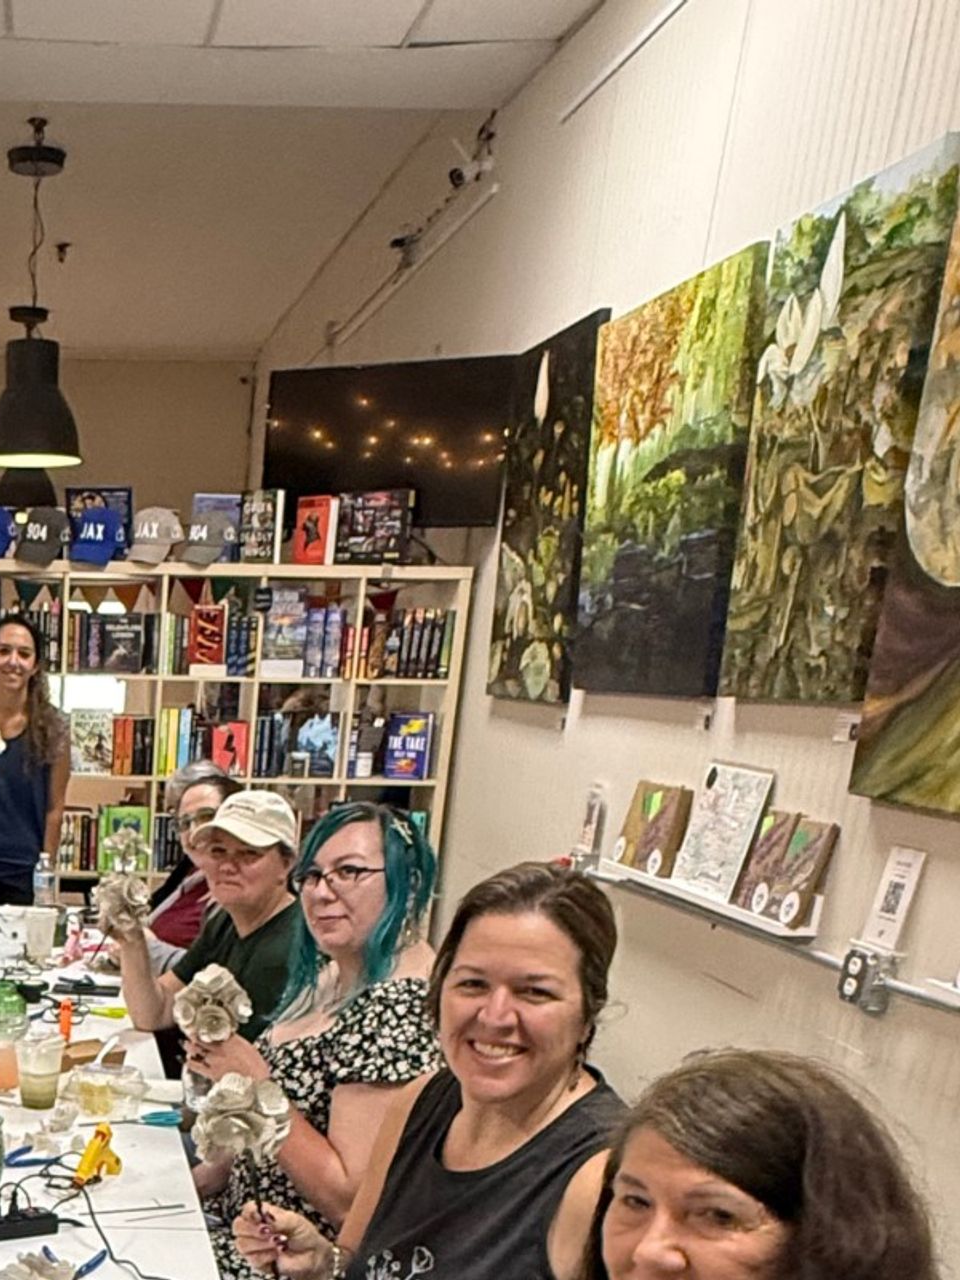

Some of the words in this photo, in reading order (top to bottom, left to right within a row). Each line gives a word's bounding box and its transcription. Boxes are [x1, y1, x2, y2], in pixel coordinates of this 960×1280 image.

[26, 521, 48, 542] 904
[80, 521, 105, 541] JAX
[134, 521, 160, 540] JAX
[388, 734, 404, 751] THE
[405, 735, 426, 752] TAKE
